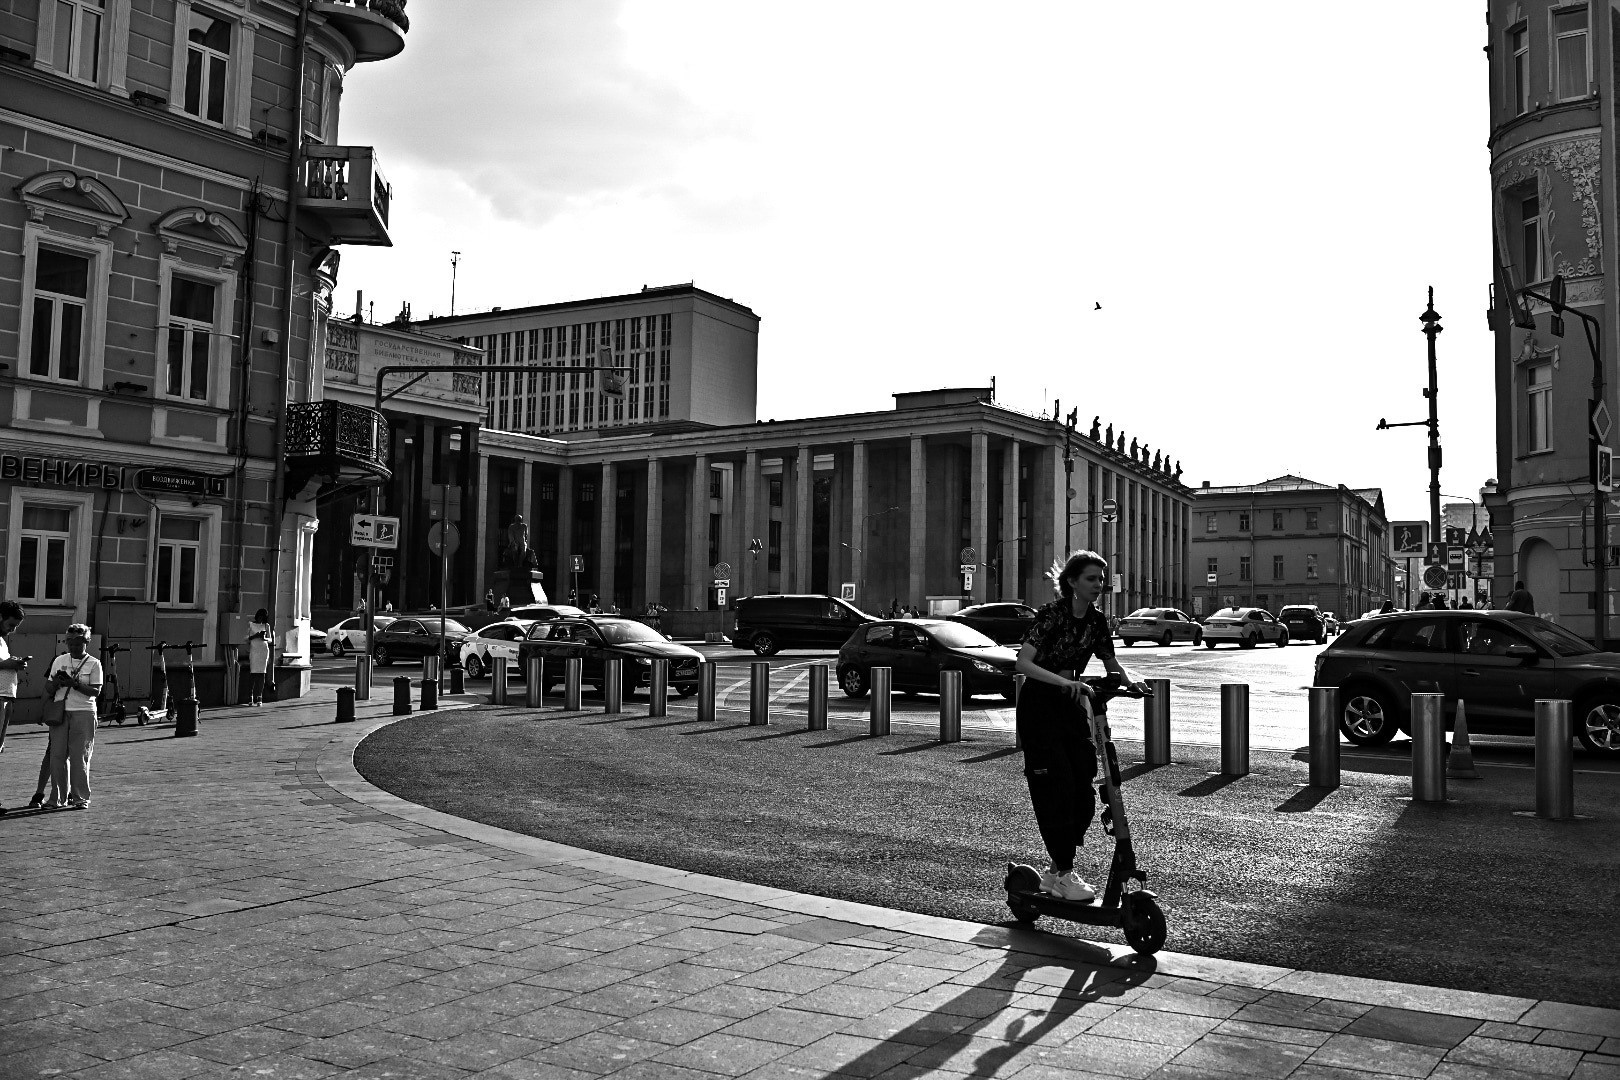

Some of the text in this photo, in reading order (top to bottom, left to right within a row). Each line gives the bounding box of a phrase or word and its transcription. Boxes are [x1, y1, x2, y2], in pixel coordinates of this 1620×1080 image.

[374, 339, 441, 359] ГОСУДАРСТВЕННАЯ
[374, 348, 419, 363] БИБЛИОТЕКА
[0, 454, 125, 491] ВЕНИРЫ
[152, 474, 196, 486] ВОЗДВИЖЕНКА
